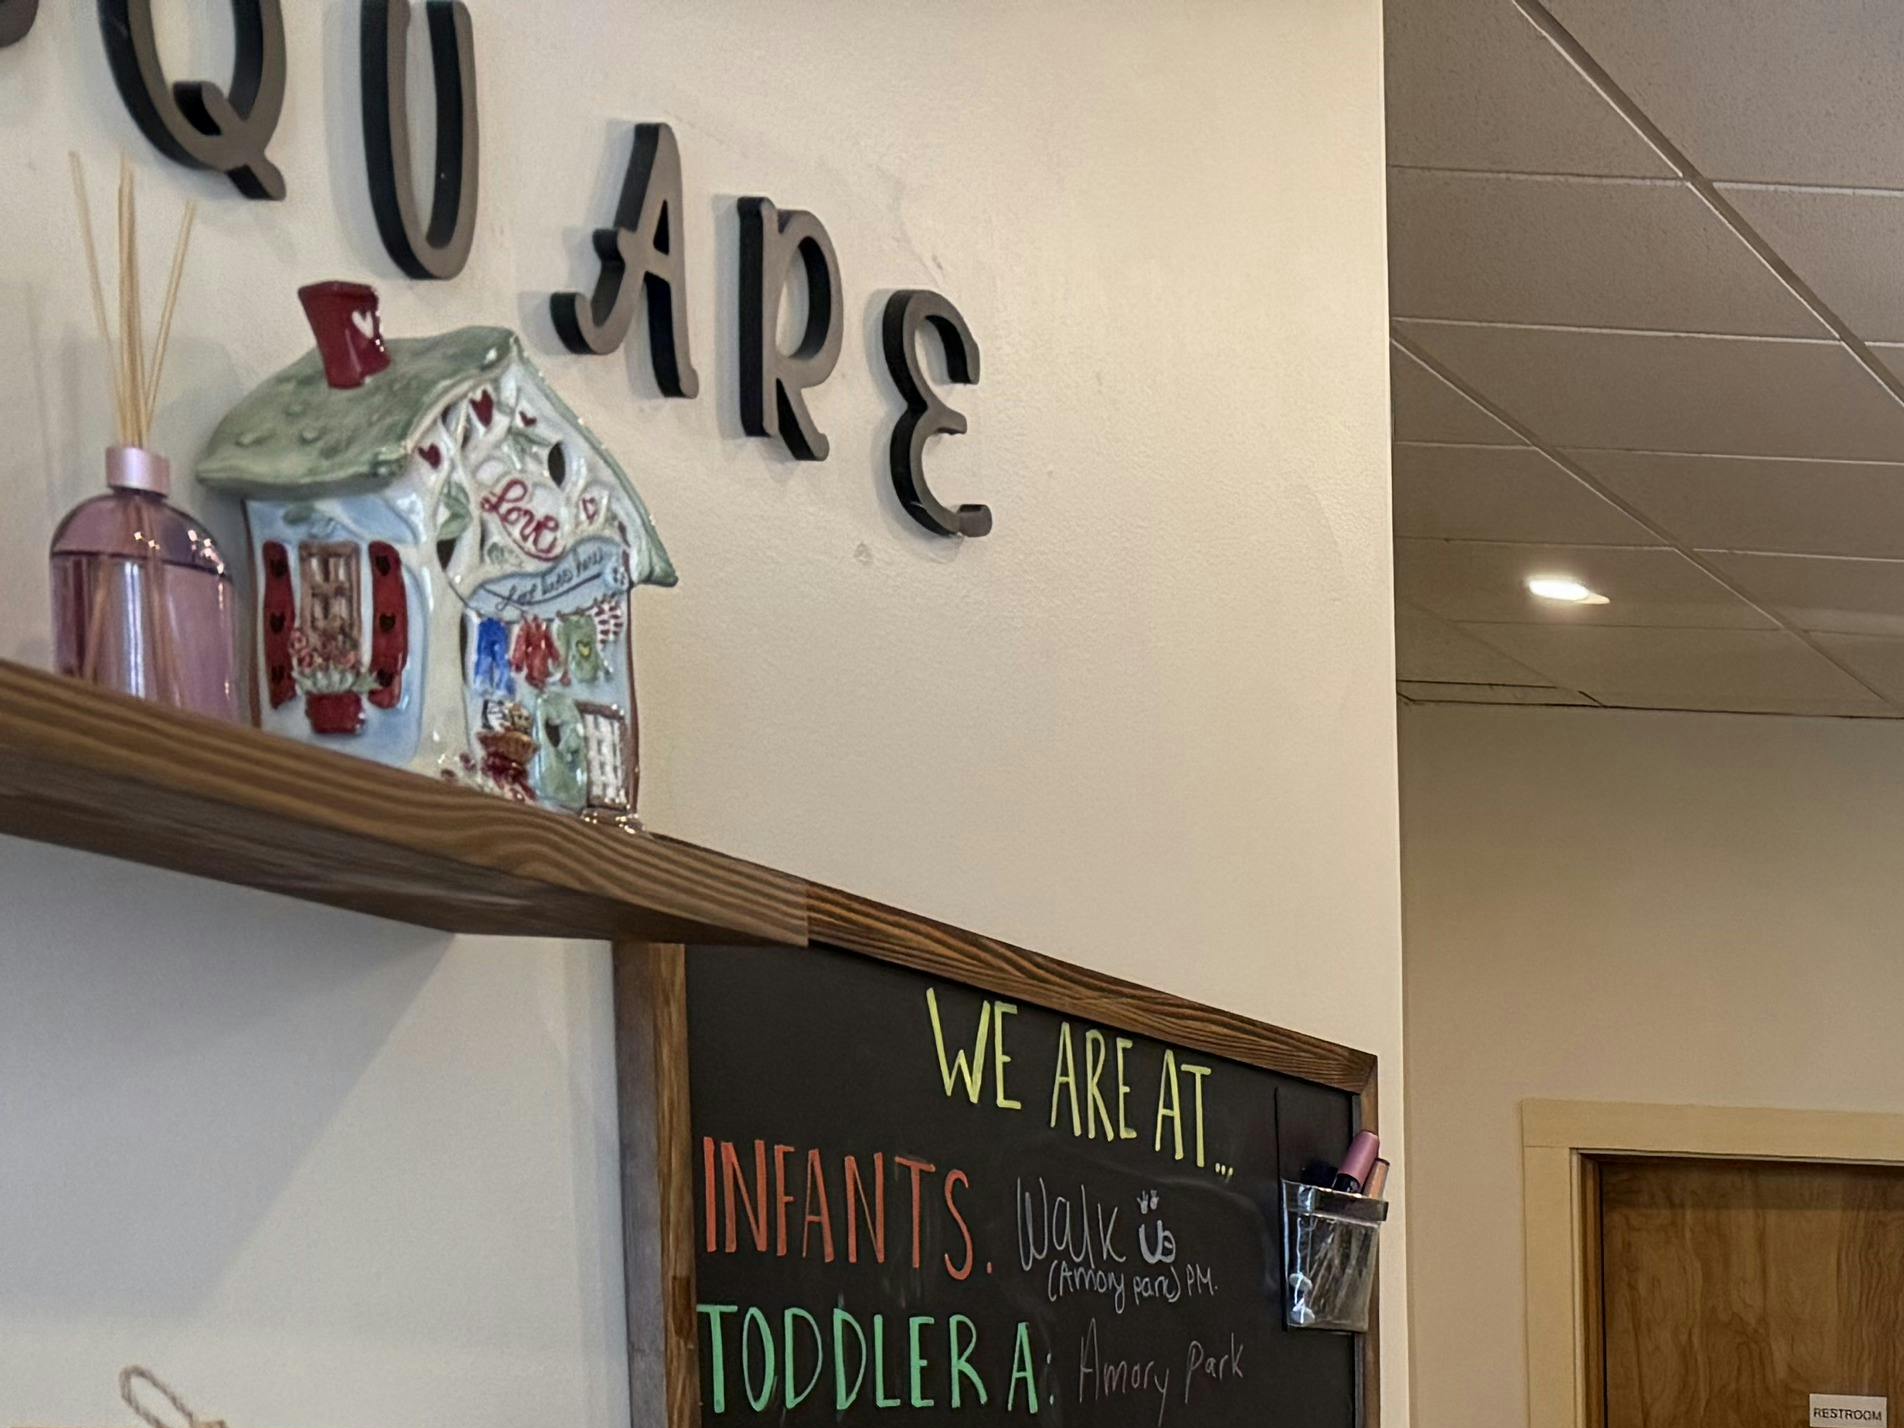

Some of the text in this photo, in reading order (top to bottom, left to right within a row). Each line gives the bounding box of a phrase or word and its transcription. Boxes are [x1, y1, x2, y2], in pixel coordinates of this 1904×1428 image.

[0, 0, 992, 540] QUARE
[480, 478, 561, 556] Love
[925, 987, 1022, 1110] WE
[1050, 1021, 1137, 1142] ARE
[1016, 1177, 1126, 1271] Walk
[696, 1303, 987, 1413] TODDLER
[1007, 1320, 1055, 1414] A:
[1077, 1316, 1170, 1428] Amory
[1813, 1407, 1882, 1421] RESTROOM
